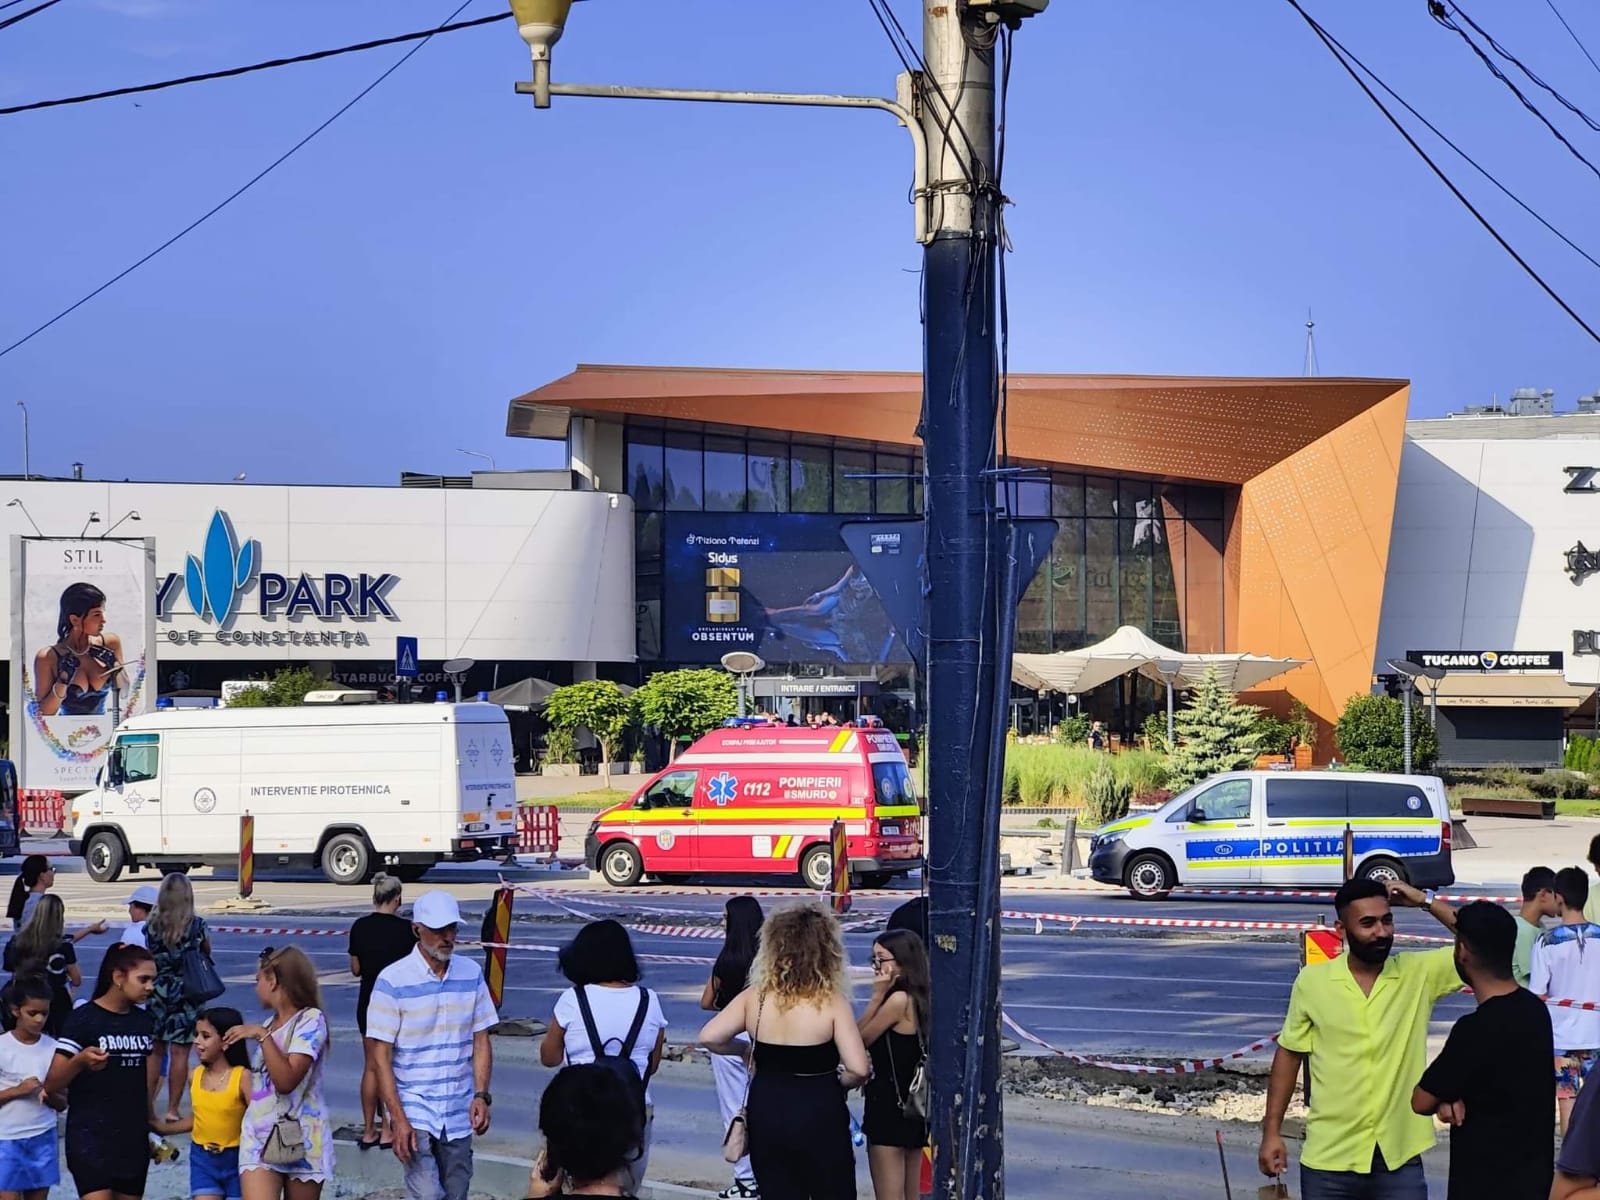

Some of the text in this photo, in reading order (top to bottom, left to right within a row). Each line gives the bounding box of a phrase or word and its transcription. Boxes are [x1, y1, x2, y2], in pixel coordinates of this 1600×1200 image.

[63, 549, 103, 563] STIL
[259, 573, 393, 617] PARK
[167, 630, 366, 642] OF CONSTANTA
[692, 632, 754, 641] OBSENTUM
[1422, 655, 1550, 666] TUCANO COFFEE
[778, 776, 842, 788] POMPIERII
[250, 784, 391, 796] INTERVENTIE PIROTEHNICA
[791, 790, 828, 799] SMURD
